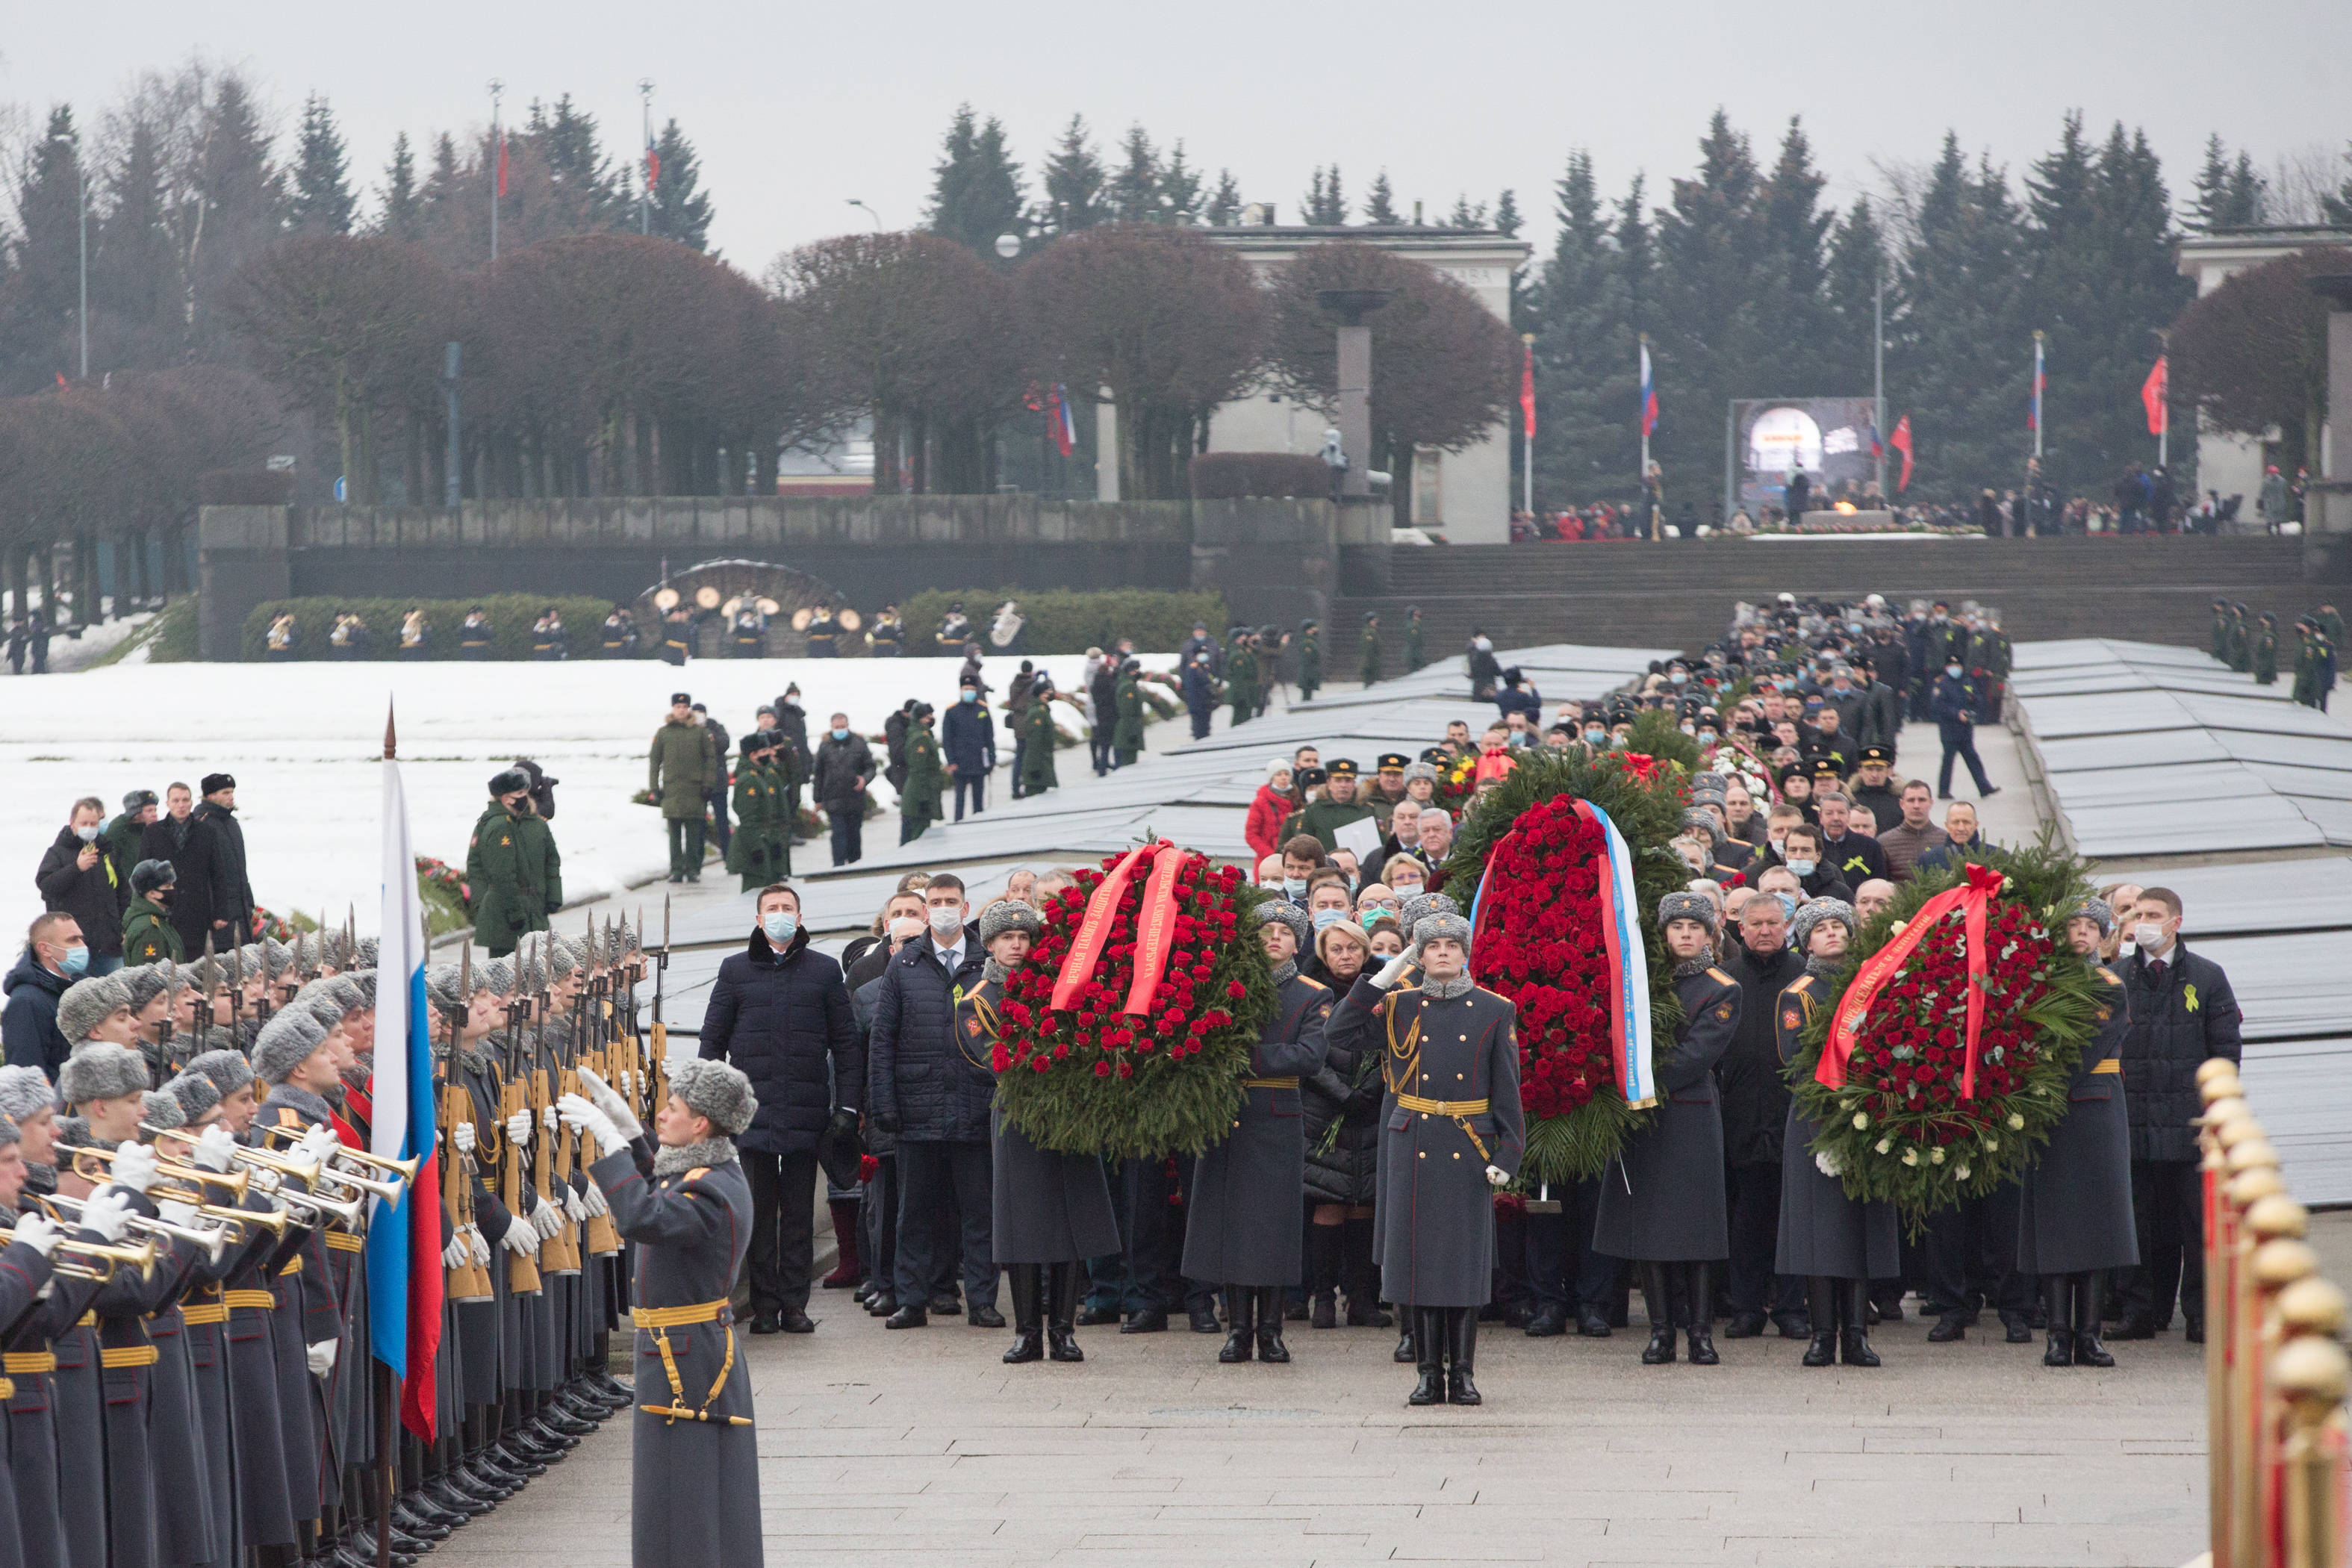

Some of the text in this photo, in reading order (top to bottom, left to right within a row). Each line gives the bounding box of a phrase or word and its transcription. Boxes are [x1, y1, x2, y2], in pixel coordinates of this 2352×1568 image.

[1066, 951, 1087, 984] ВЕЧНАЯ
[1077, 920, 1099, 950] ПАМЯТЬ
[1143, 904, 1166, 979] САНКТ-ПЕТЕРБУРГА
[1841, 961, 1887, 1025] ПРЕДСЕДАТЕЛЯ
[1837, 1025, 1849, 1039] ОТ
